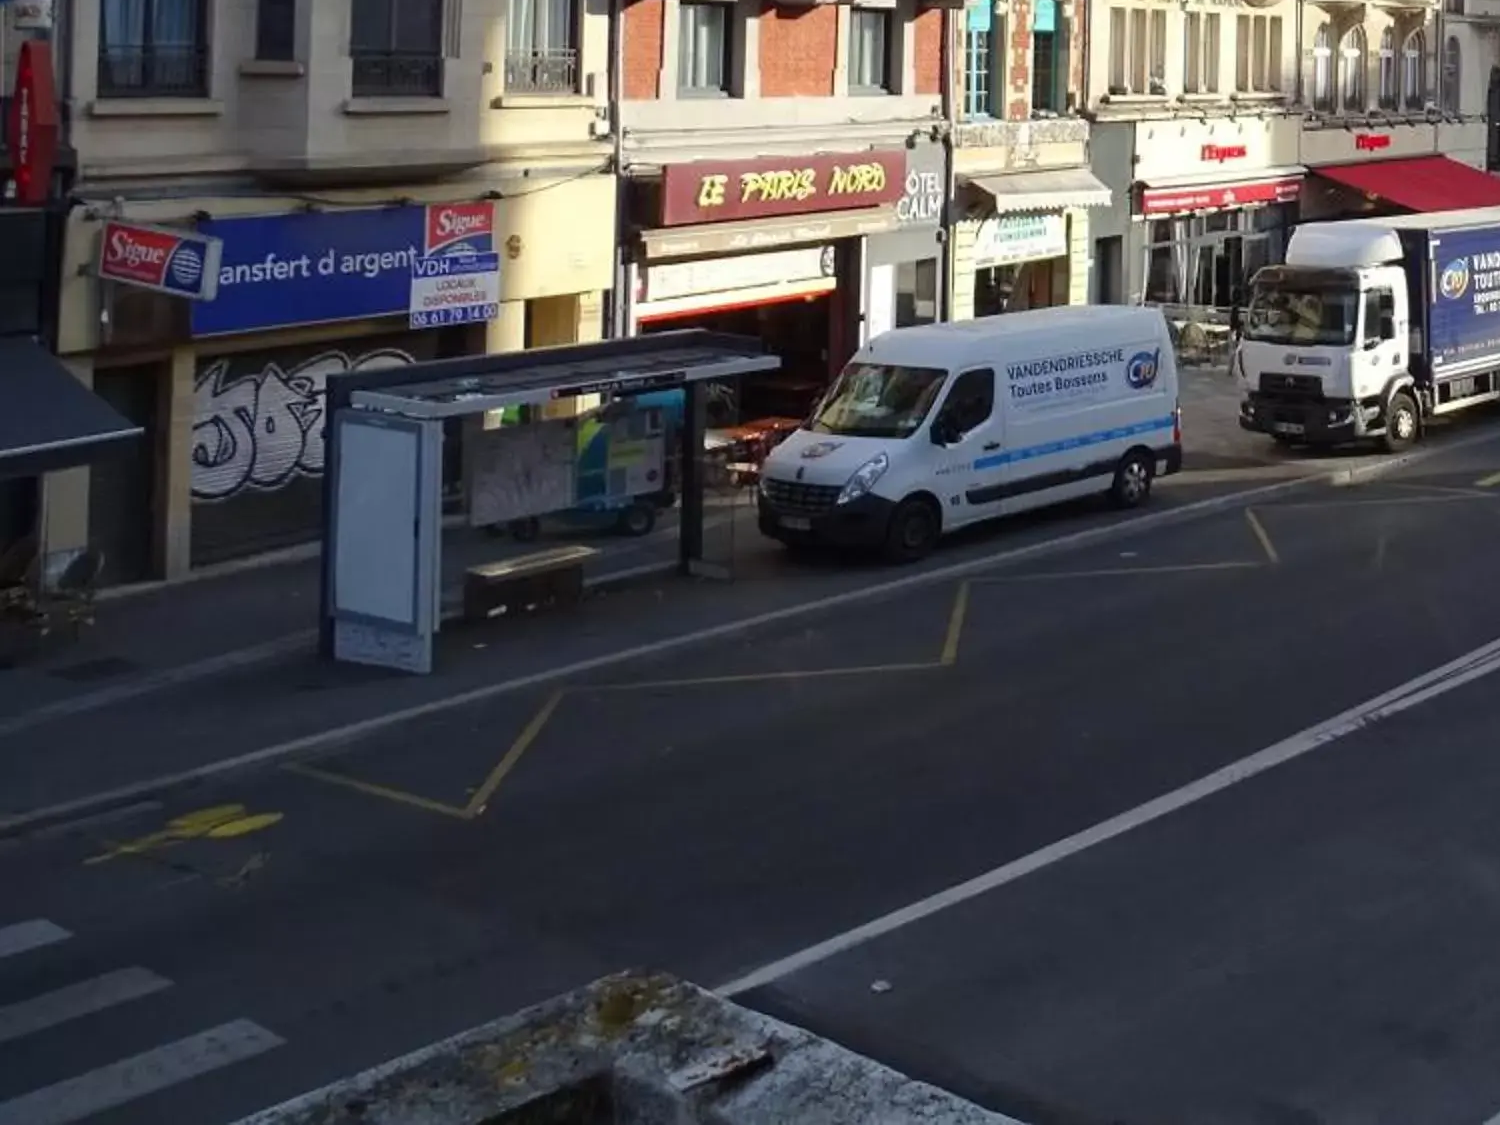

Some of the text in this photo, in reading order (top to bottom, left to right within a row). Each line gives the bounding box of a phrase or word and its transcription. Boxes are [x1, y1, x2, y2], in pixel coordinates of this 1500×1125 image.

[698, 162, 887, 207] LE PARIS NORD
[905, 169, 944, 194] ÔTEL
[436, 209, 487, 236] Sigue
[106, 230, 165, 268] Sigue
[219, 253, 311, 286] ansfert
[340, 245, 418, 278] argent
[415, 258, 450, 275] VDH
[1007, 349, 1125, 380] VANDENDRIESSCHE
[1010, 381, 1051, 398] Toutes
[1055, 371, 1109, 390] Boissons
